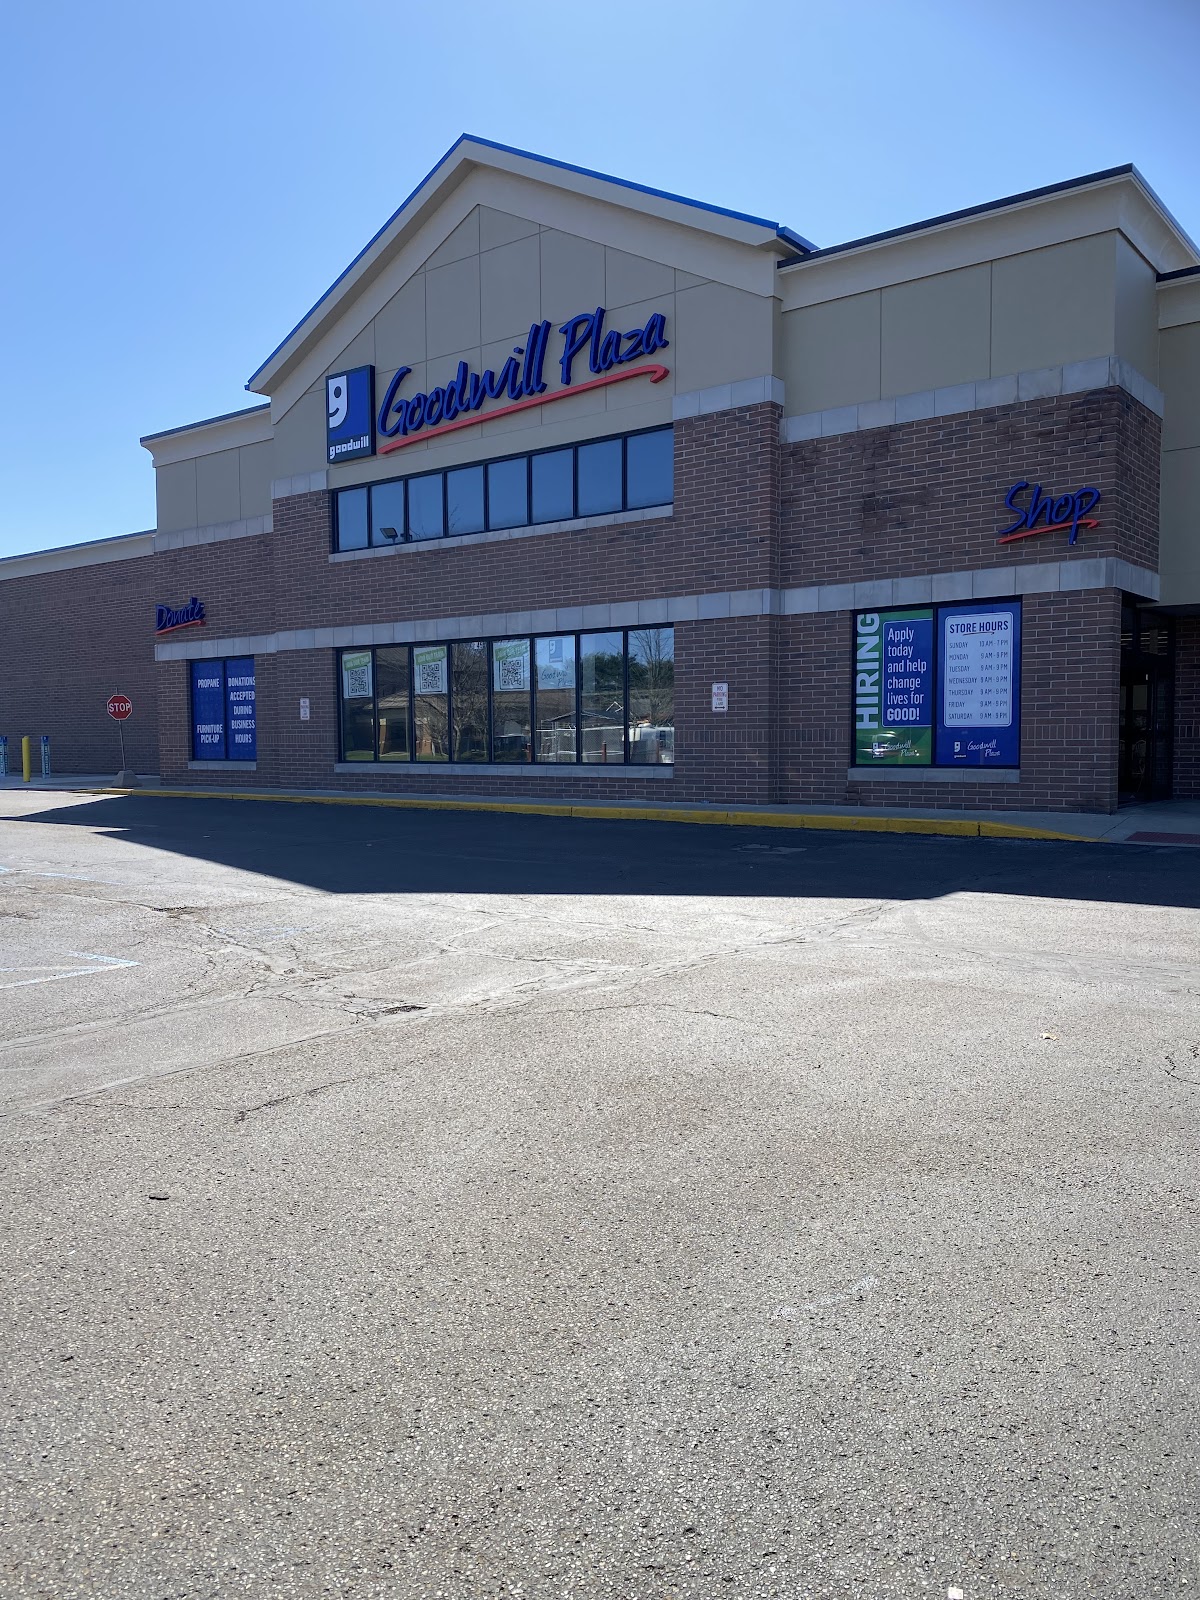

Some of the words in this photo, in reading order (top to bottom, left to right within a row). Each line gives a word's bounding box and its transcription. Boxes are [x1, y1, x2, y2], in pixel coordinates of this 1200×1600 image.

[377, 320, 551, 437] Goodwill
[559, 306, 669, 385] Plaza
[329, 435, 369, 459] goodwill
[998, 480, 1101, 545] Shop
[155, 597, 205, 631] Donate
[949, 622, 977, 634] STORE
[979, 620, 1009, 632] HOURS
[887, 626, 914, 643] Apply
[949, 641, 968, 649] SUNDAY
[887, 643, 914, 659] today
[949, 653, 969, 661] MONDAY
[856, 613, 880, 729] HIRING
[887, 659, 905, 673] and
[906, 658, 927, 674] help
[949, 665, 970, 673] TUESDAY
[198, 679, 219, 688] PROPANE
[228, 677, 255, 686] DONATIONS
[887, 676, 921, 691] change
[948, 677, 978, 685] WEDNESDAY
[230, 691, 255, 701] ACCEPTED
[887, 691, 908, 705] lives
[910, 691, 924, 704] for
[109, 703, 131, 713] STOP
[233, 706, 252, 715] DURING
[886, 707, 920, 721] GOOD!
[197, 724, 223, 734] FURNITURE
[231, 720, 255, 729] BUSINESS
[200, 735, 219, 744] PICK-UP
[235, 734, 252, 743] HOURS
[967, 739, 997, 751] Goodwill
